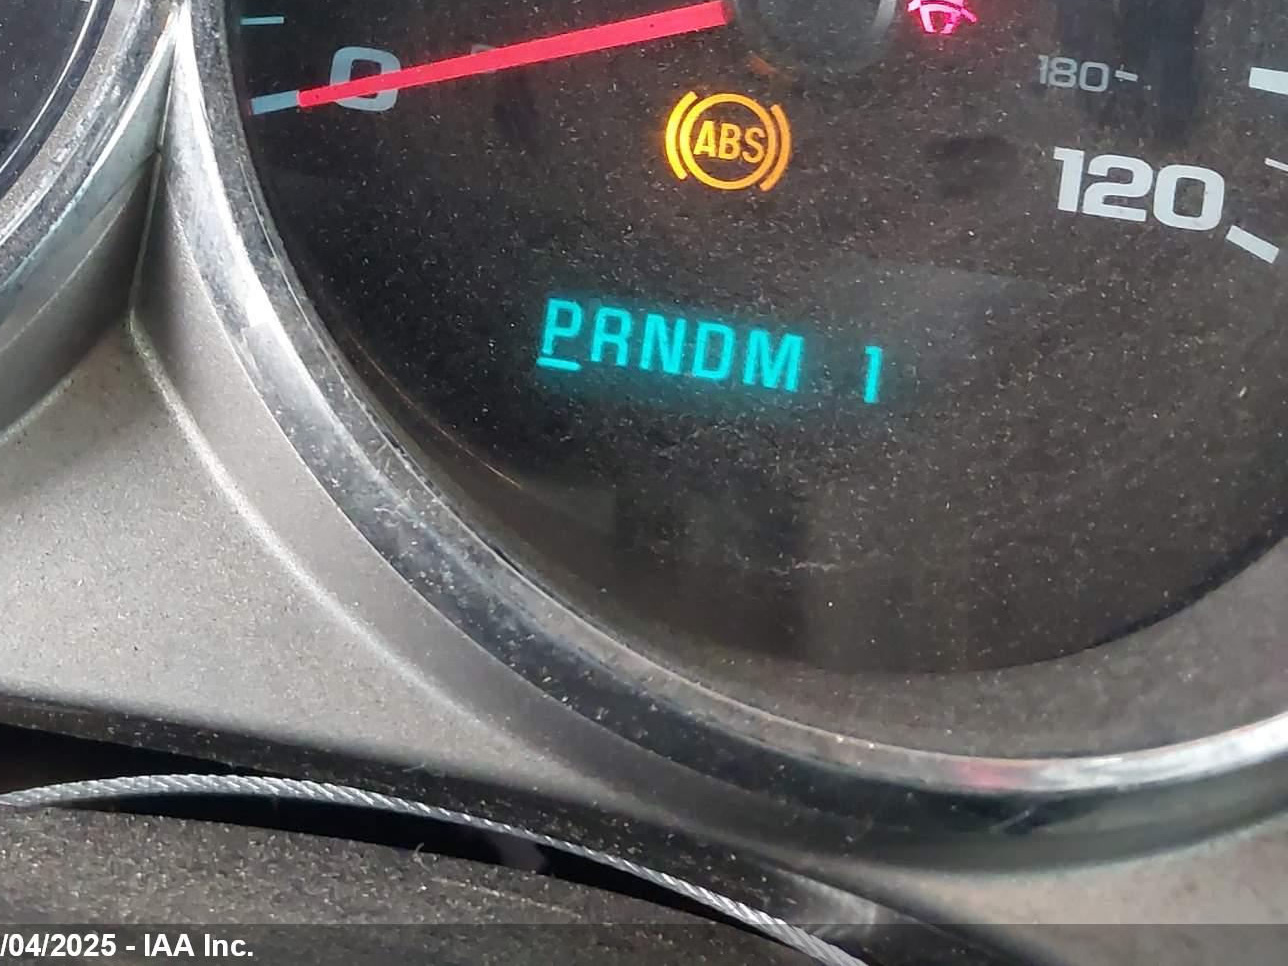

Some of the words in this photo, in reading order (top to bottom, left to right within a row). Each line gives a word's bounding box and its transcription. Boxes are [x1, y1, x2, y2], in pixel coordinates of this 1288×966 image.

[330, 46, 401, 111] 0
[1039, 55, 1109, 91] 180
[693, 121, 765, 163] ABS
[1054, 147, 1224, 230] 120
[541, 298, 805, 393] PRNDM
[862, 345, 884, 404] 1
